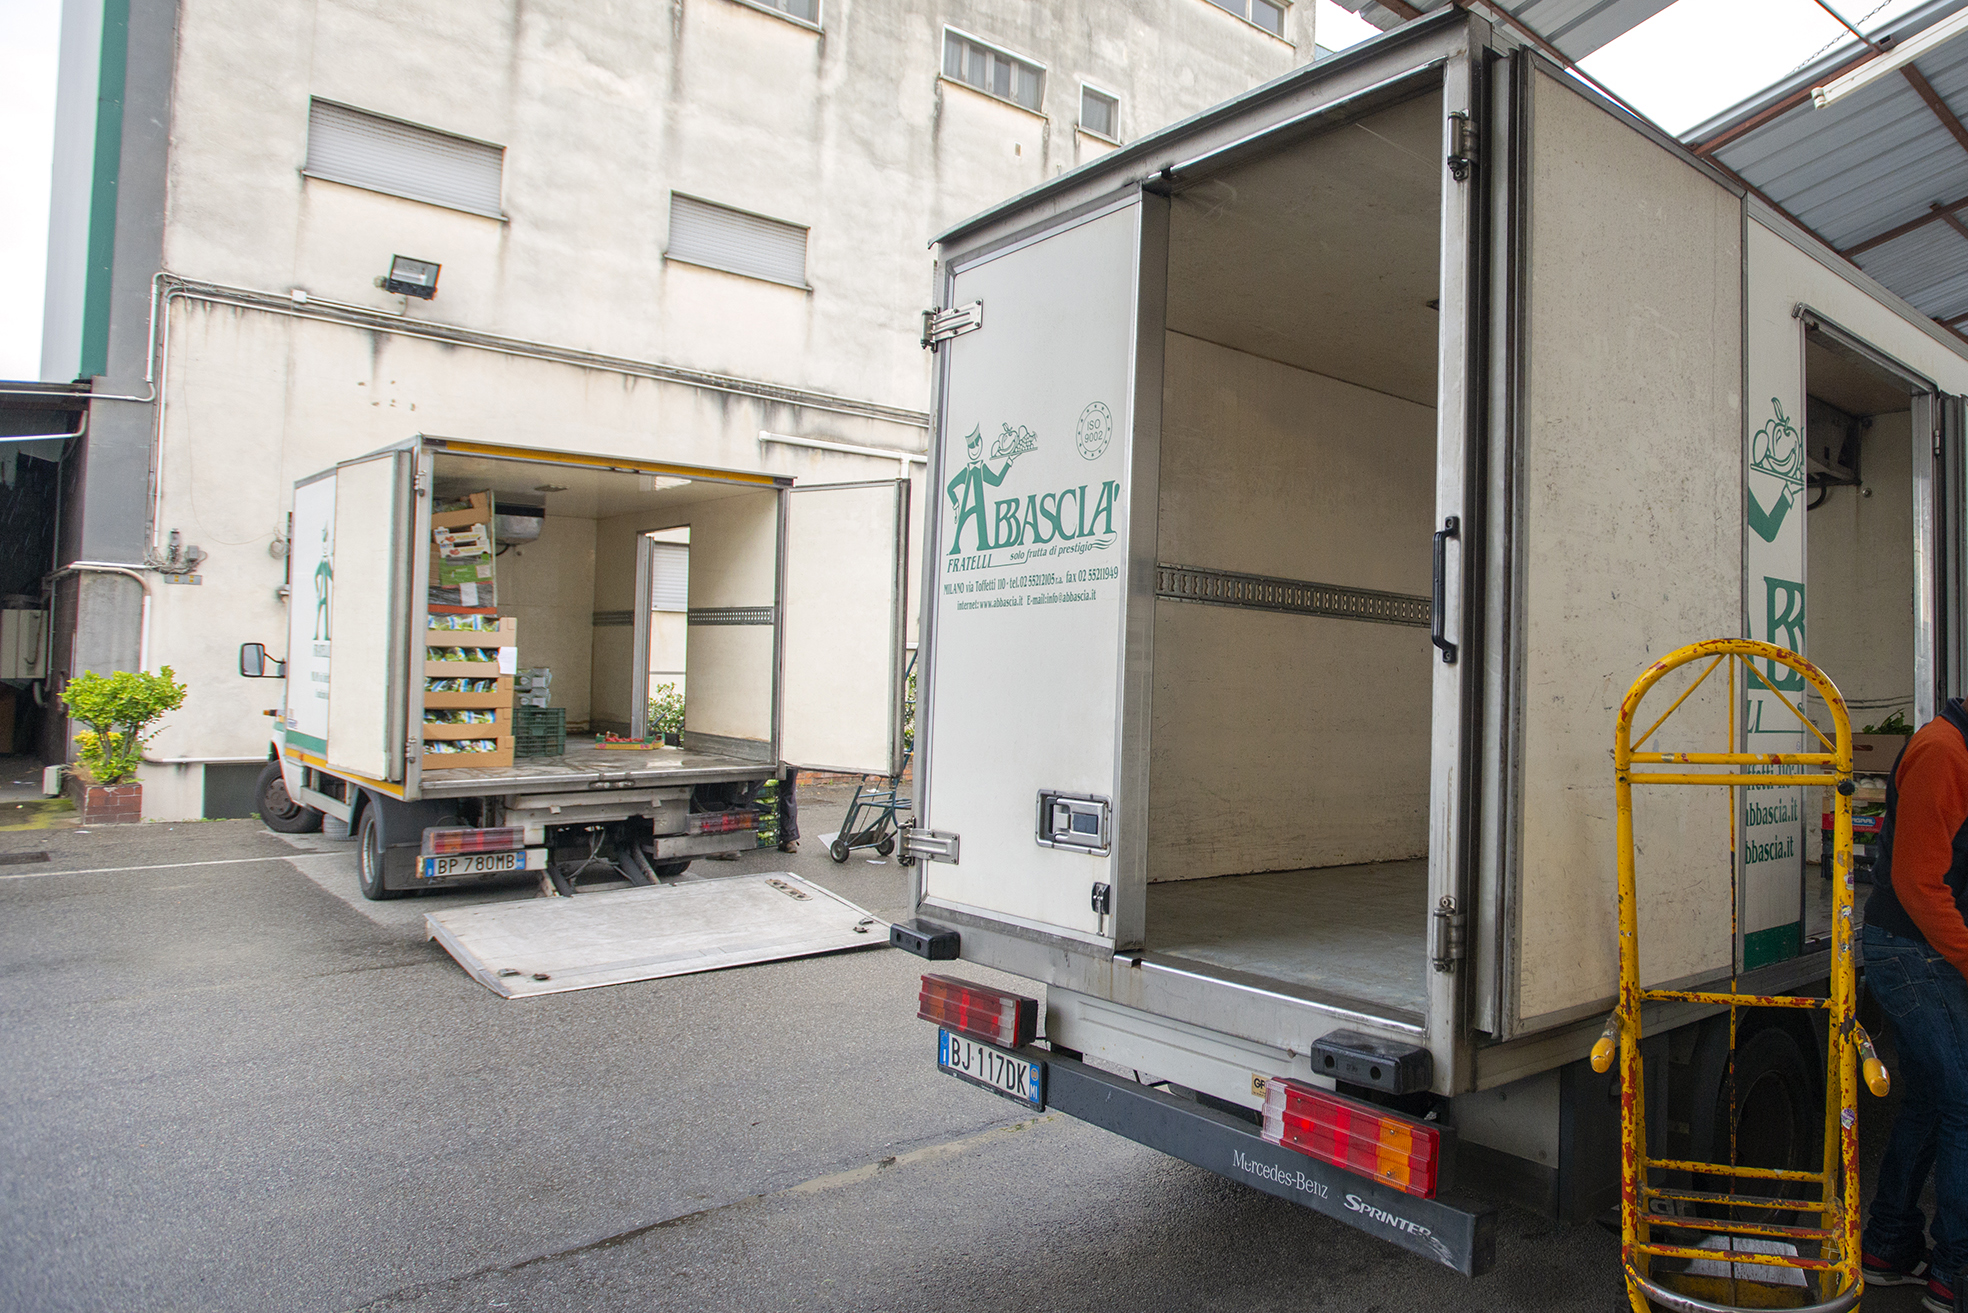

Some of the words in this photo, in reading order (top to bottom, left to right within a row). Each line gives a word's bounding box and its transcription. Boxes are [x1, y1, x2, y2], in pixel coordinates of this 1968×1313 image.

[1087, 418, 1101, 431] ISO
[1084, 430, 1103, 443] 9002
[1010, 551, 1024, 561] solo
[1027, 547, 1047, 559] frutta
[1049, 545, 1057, 556] di
[1057, 541, 1093, 557] prestigio
[947, 553, 992, 573] FRATELLI
[943, 582, 964, 595] MILANO
[966, 581, 974, 593] via
[975, 578, 996, 592] Toffetti
[1066, 570, 1077, 583] fax
[1078, 569, 1087, 582] 02
[1088, 566, 1119, 581] 55211949
[438, 858, 459, 874] BP
[464, 854, 515, 872] 780MB
[952, 1037, 971, 1071] BJ
[978, 1047, 1027, 1096] 117DK
[1030, 1084, 1038, 1100] MI
[1232, 1149, 1329, 1200] Mercedes-Benz
